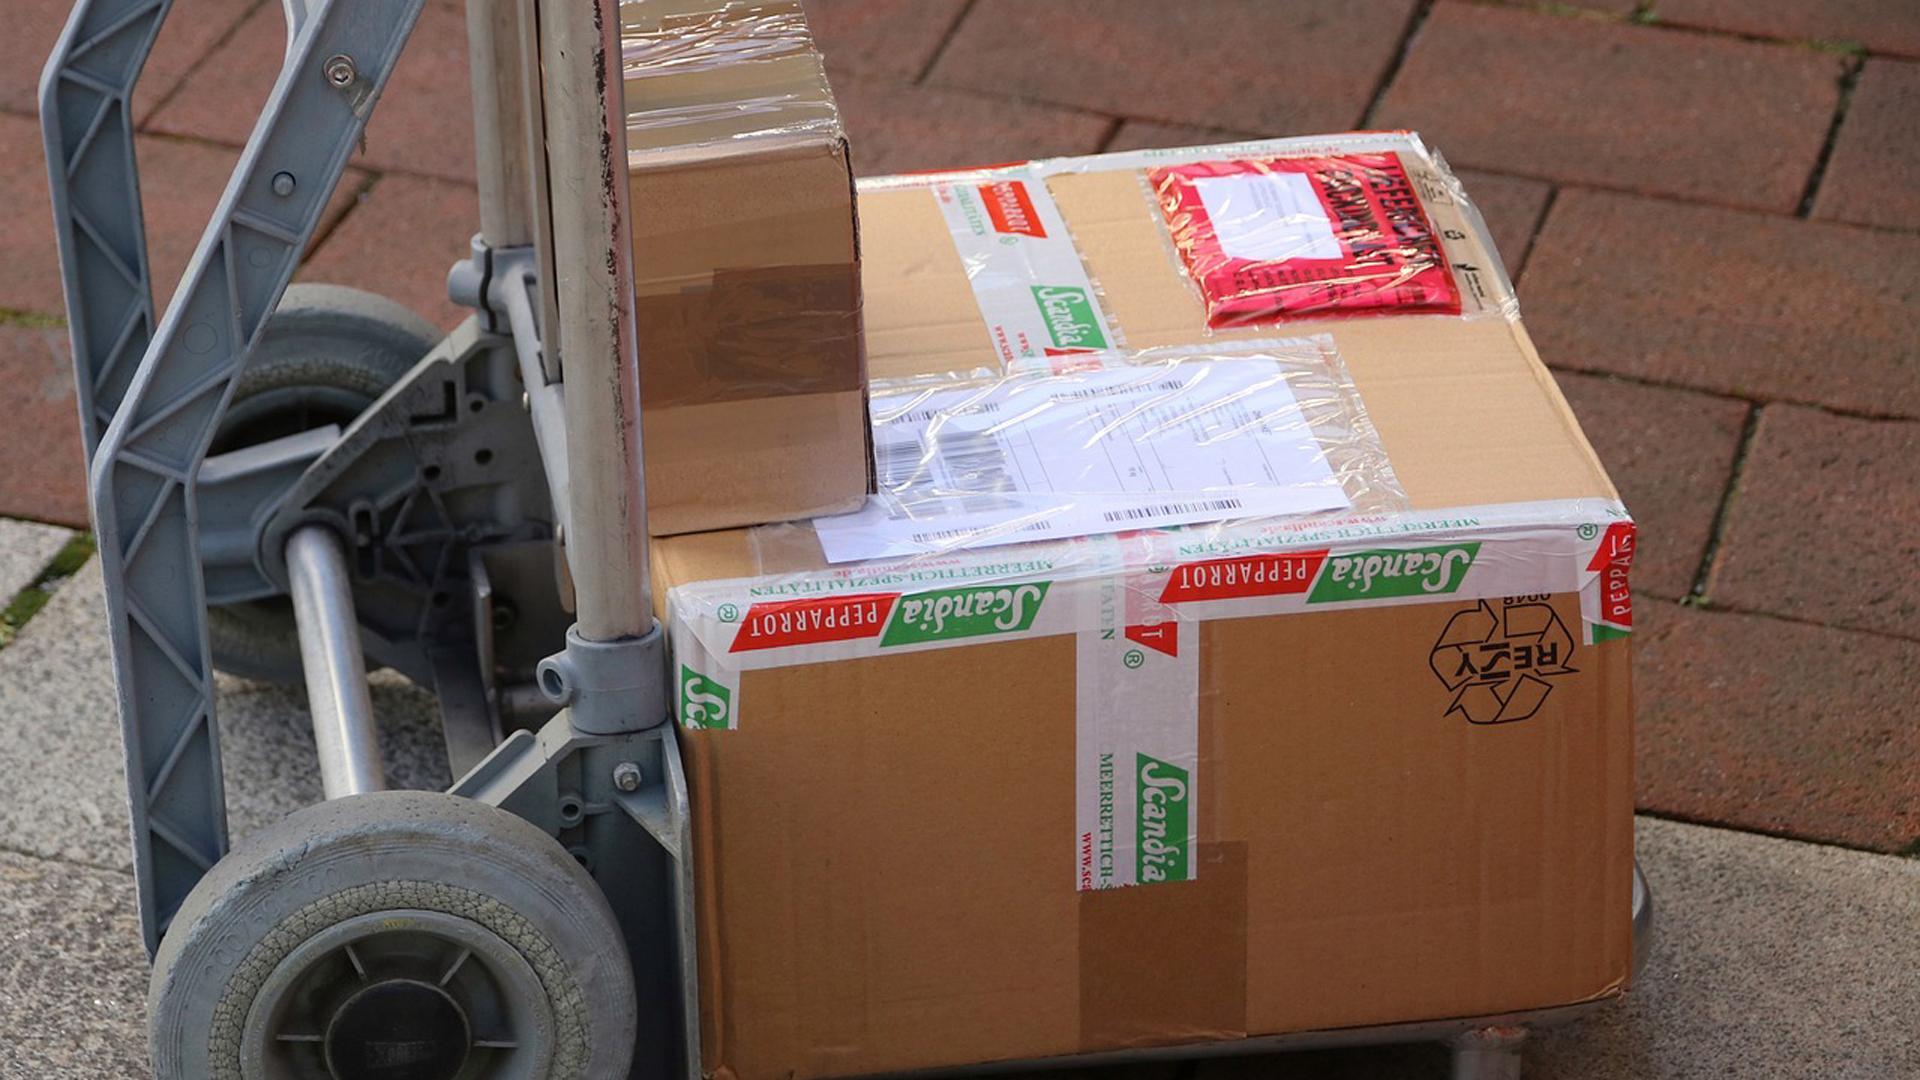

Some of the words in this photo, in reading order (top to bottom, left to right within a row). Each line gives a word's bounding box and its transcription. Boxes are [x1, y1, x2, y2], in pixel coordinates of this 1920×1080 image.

[1038, 287, 1090, 346] Scandia
[1180, 559, 1306, 590] PEPPARROT
[1332, 548, 1471, 593] Scandia
[752, 601, 878, 638] PEPPARROT
[903, 583, 1043, 632] Scandia
[1141, 761, 1187, 884] Scandia
